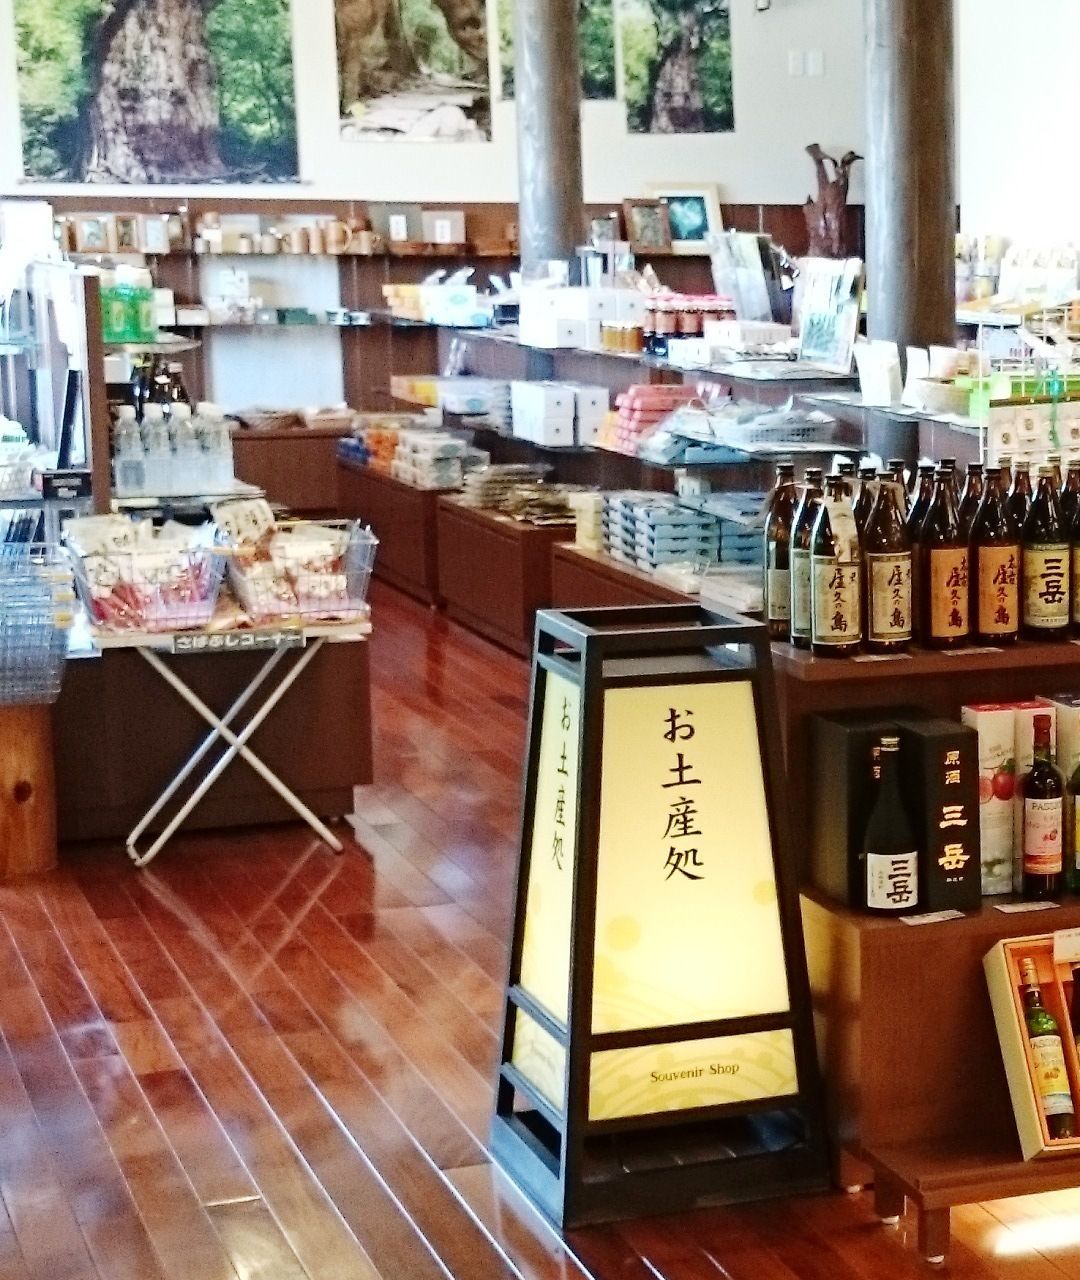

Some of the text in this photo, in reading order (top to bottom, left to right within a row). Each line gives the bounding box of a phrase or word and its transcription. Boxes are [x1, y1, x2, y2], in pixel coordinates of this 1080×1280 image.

[828, 568, 848, 633] 屋久の島
[888, 566, 905, 629] 屋久の島
[1039, 558, 1066, 604] 三岳
[552, 696, 571, 871] お土産処
[661, 707, 705, 881] お土産処
[938, 805, 971, 871] 三岳
[886, 859, 913, 904] 三岳
[650, 1062, 740, 1083] Souvenir Shop
